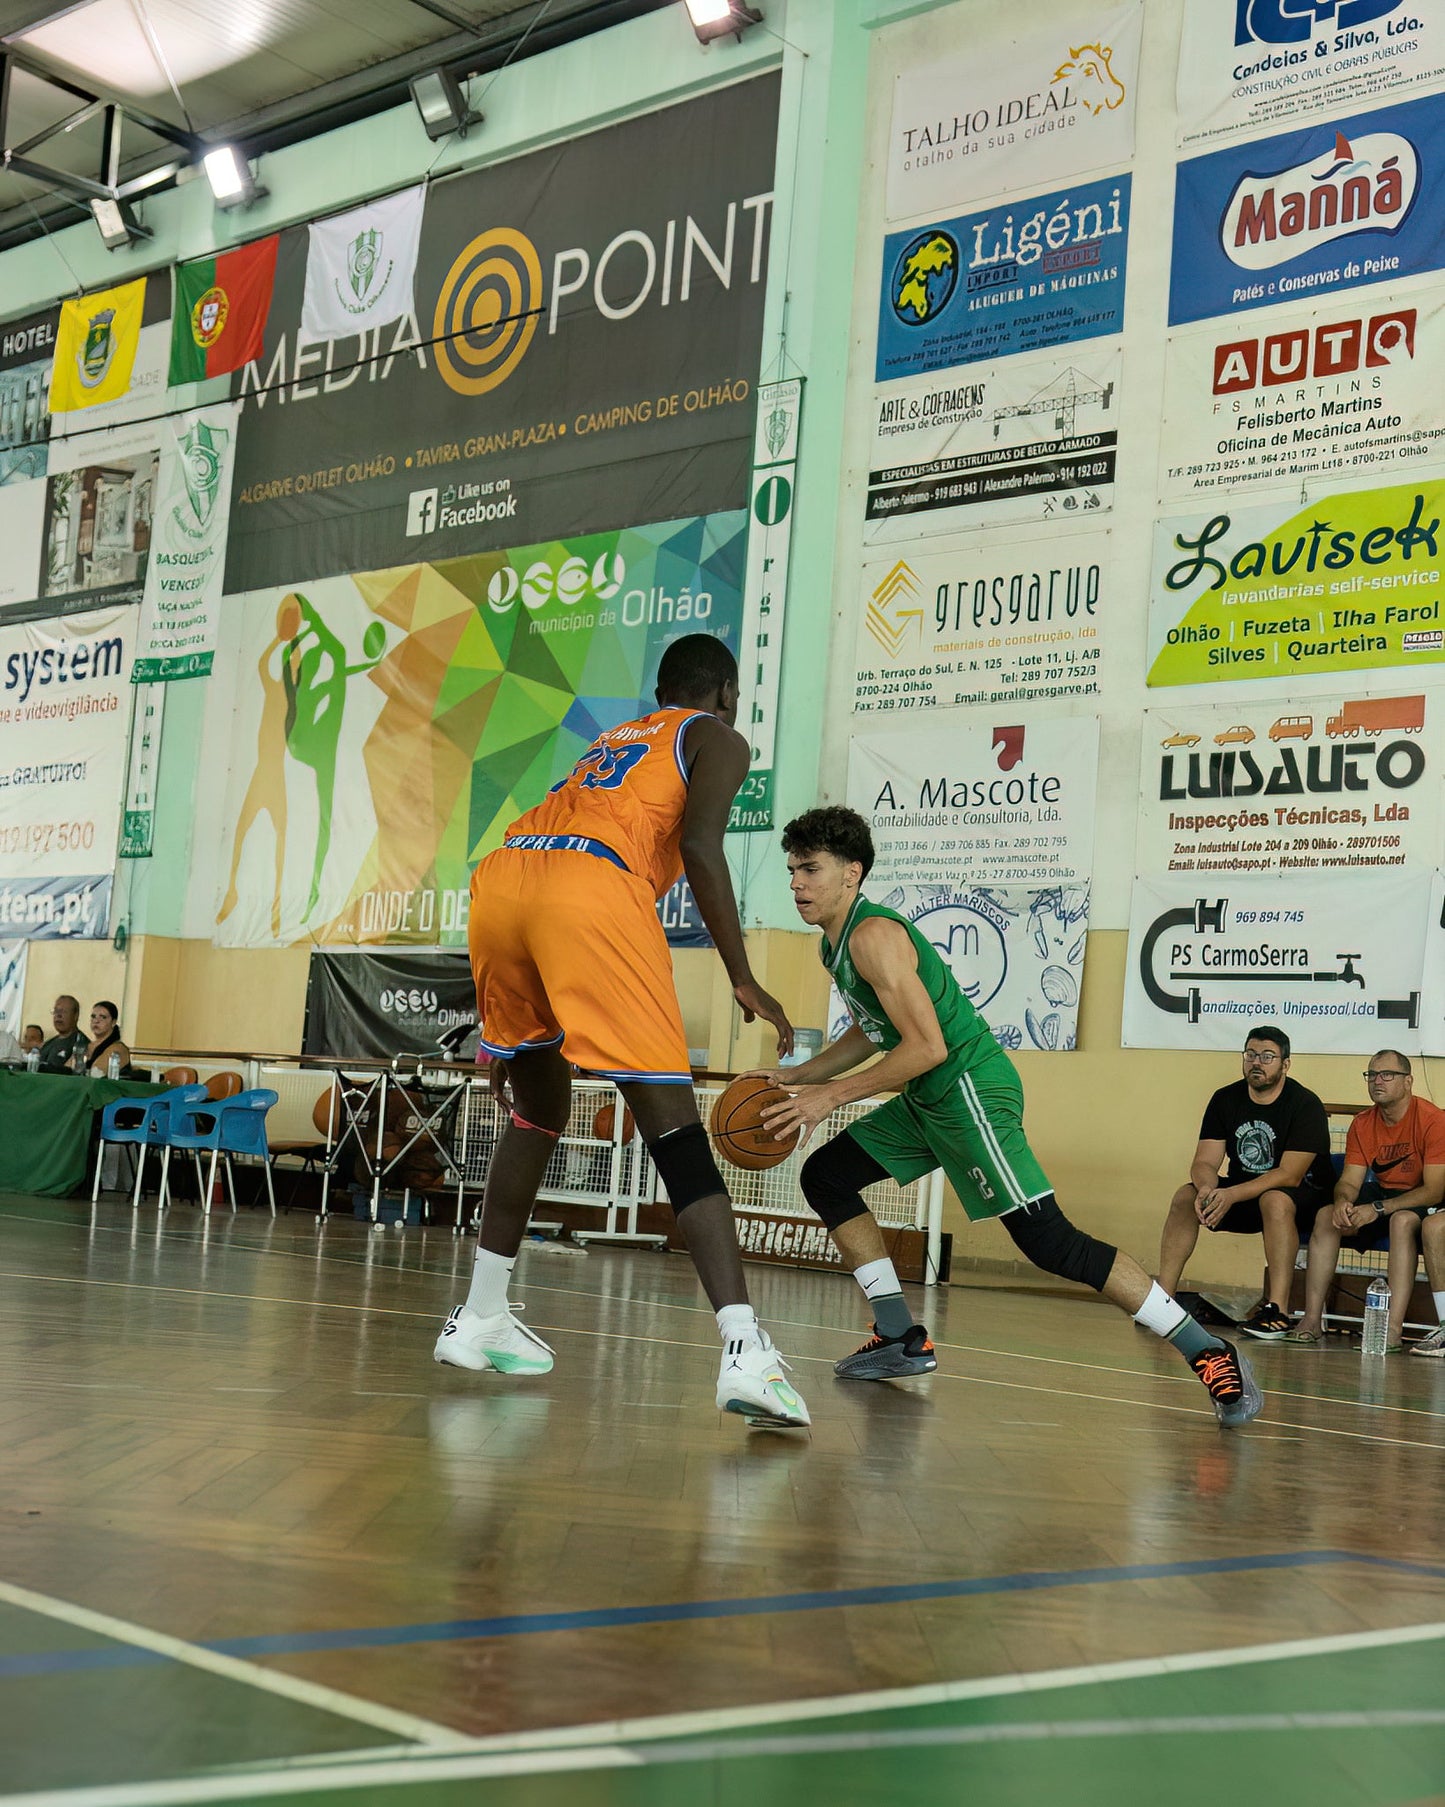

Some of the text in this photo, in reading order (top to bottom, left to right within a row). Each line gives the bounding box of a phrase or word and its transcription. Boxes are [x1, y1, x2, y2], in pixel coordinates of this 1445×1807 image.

[1232, 48, 1307, 81] Candeias
[1314, 41, 1328, 58] &
[1334, 28, 1378, 53] Silva,
[1387, 16, 1424, 37] Lda.
[1232, 73, 1299, 100] CONSTRUÇÃO
[1300, 66, 1323, 83] CIVIL
[1334, 53, 1368, 73] OBRAS
[903, 86, 1078, 154] TALHO IDEAL
[915, 114, 1077, 169] talho da sua cidade
[1234, 156, 1402, 248] Manná
[969, 189, 1123, 268] Ligéni
[548, 191, 775, 335] POINT
[967, 265, 1019, 290] IMPORT
[1232, 255, 1400, 304] Patés Conservas de Peixe
[968, 266, 1119, 312] ALUGUER DE MÁQUINAS
[2, 322, 55, 358] HOTEL
[1214, 312, 1413, 391] AUTO
[237, 312, 427, 416] MEDIA
[574, 376, 750, 435] CAMPING DE OLHÃO
[879, 383, 985, 425] ARTE & COFRAGENS
[1236, 394, 1383, 431] Felisberto Martins
[878, 408, 984, 438] Empresa de Construção
[1217, 415, 1401, 454] Oficina de Mecânica Auto
[238, 424, 557, 504] ALGARVE OUTLET OLHÃO TAVIRA GRAN-PLAZA
[941, 459, 956, 471] EM
[956, 449, 1013, 469] ESTRUTURAS
[1013, 448, 1026, 460] DE
[1026, 441, 1057, 457] BETÃO
[1057, 434, 1102, 452] ARMADO
[1187, 465, 1203, 476] 289
[1205, 461, 1221, 473] 723
[1280, 450, 1297, 462] 213
[1301, 447, 1317, 459] 172
[1217, 445, 1429, 485] Empresarial de Marim 8700-221 Olhão
[457, 479, 512, 502] Like us on
[1023, 471, 1056, 487] Palermo
[439, 494, 517, 531] Facebook
[1164, 494, 1442, 594] Lavisek
[936, 564, 1101, 634] gresgarve
[1221, 568, 1441, 606] lavandarias self-service
[529, 609, 616, 637] município de
[621, 586, 713, 627] Olhão
[1166, 600, 1440, 646] Olhão Fuzeta Ilha Farol
[932, 625, 1098, 653] materiais lda
[1207, 645, 1265, 668] Silves
[1287, 633, 1388, 662] Quarteira
[5, 636, 123, 706] system
[857, 648, 1101, 682] Urb. Terraço do Sul, 125 Lote 11, A/B
[1000, 664, 1097, 685] Tel: 289 707 752/3
[854, 699, 875, 713] Fax:
[876, 697, 896, 711] 289
[898, 696, 917, 709] 707
[919, 694, 937, 708] 754
[954, 690, 989, 706] Email:
[856, 678, 933, 696] 8700-224 Olhão
[24, 693, 120, 724] videovigilância
[1160, 739, 1426, 801] LUISAUTO
[873, 771, 1062, 812] A. Mascote
[730, 802, 771, 827] Anos
[872, 806, 1063, 829] Contabilidade Consultoria, Lda.
[1168, 802, 1410, 833] Inspecções Técnicas, Lda
[940, 836, 1067, 851] 289 706 289 702 795
[983, 853, 1060, 864] www.amascote.pt
[1168, 852, 1406, 871] Email: luisauto@sapo.pt Website: www.luisauto.net
[1174, 836, 1400, 854] Zona Industrial Lote 204 209 Olhão 289701506
[1049, 867, 1076, 879] Olhão
[361, 888, 473, 933] ONDE O DE
[953, 892, 1011, 932] MARISCOS
[1235, 911, 1305, 924] 969 894 745
[1170, 943, 1309, 967] PS CarmoSerra
